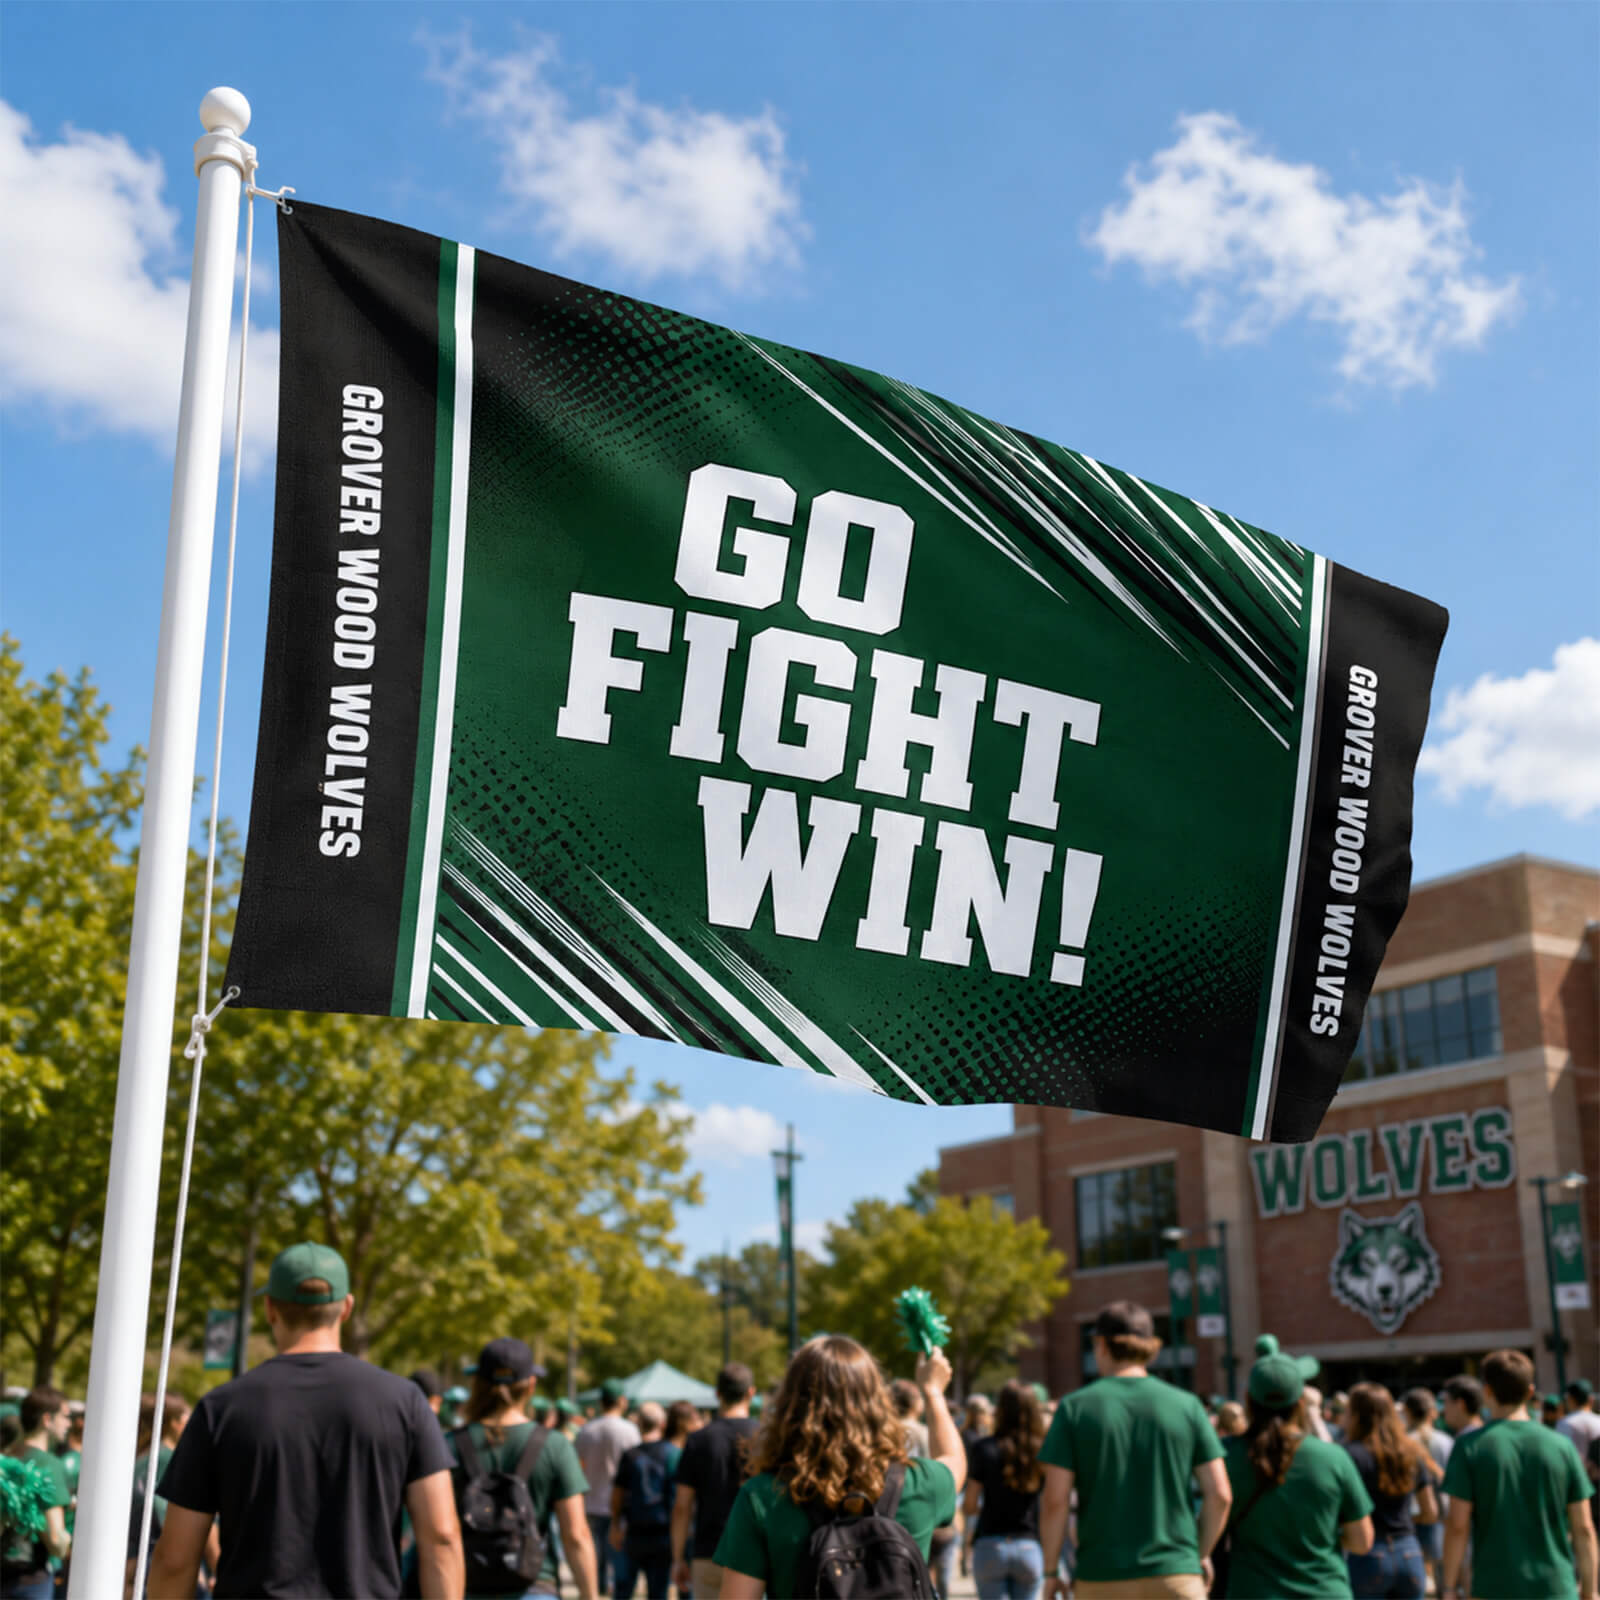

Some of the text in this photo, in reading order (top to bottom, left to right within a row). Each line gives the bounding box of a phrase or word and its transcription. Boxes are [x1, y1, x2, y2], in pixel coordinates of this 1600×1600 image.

[318, 383, 385, 858] GROVER WOOD WOLVES
[673, 462, 915, 636] GO
[556, 591, 1101, 831] FIGHT
[698, 775, 1104, 987] WIN!
[1309, 664, 1378, 1037] GROVER WOOD WOLVES
[1250, 1105, 1516, 1219] WOLVES
